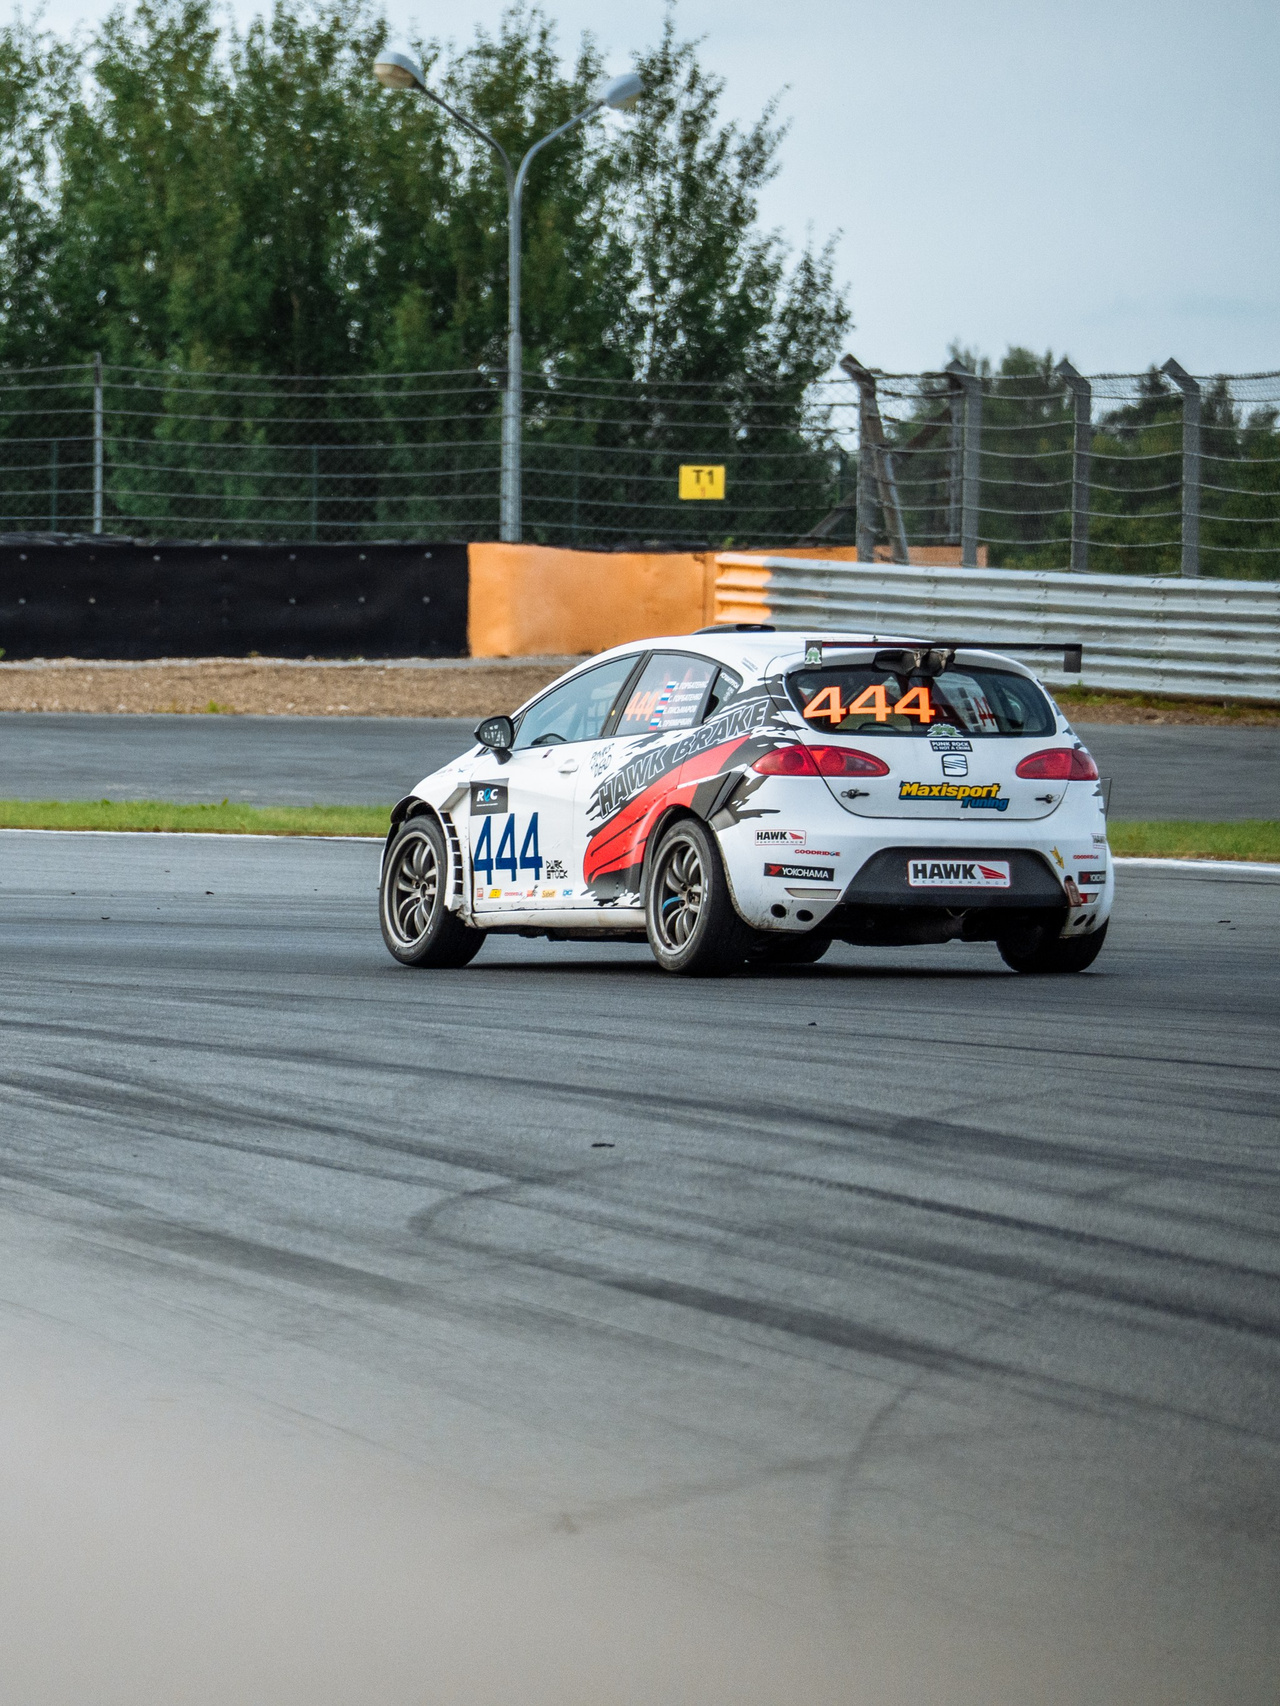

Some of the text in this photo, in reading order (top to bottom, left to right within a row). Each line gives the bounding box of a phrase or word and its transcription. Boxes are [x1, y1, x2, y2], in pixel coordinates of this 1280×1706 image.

[693, 469, 714, 485] T1
[624, 691, 660, 721] 444
[803, 685, 936, 724] 444
[598, 745, 673, 820] HAWK
[672, 700, 769, 763] BRAKE
[900, 782, 1000, 799] Maxisport
[962, 798, 1009, 811] Tuning
[756, 831, 787, 840] HAWK
[474, 812, 543, 885] 444
[794, 849, 841, 857] GOODRIDGE
[781, 867, 829, 878] YOKOHAMA
[912, 863, 977, 880] HAWK
